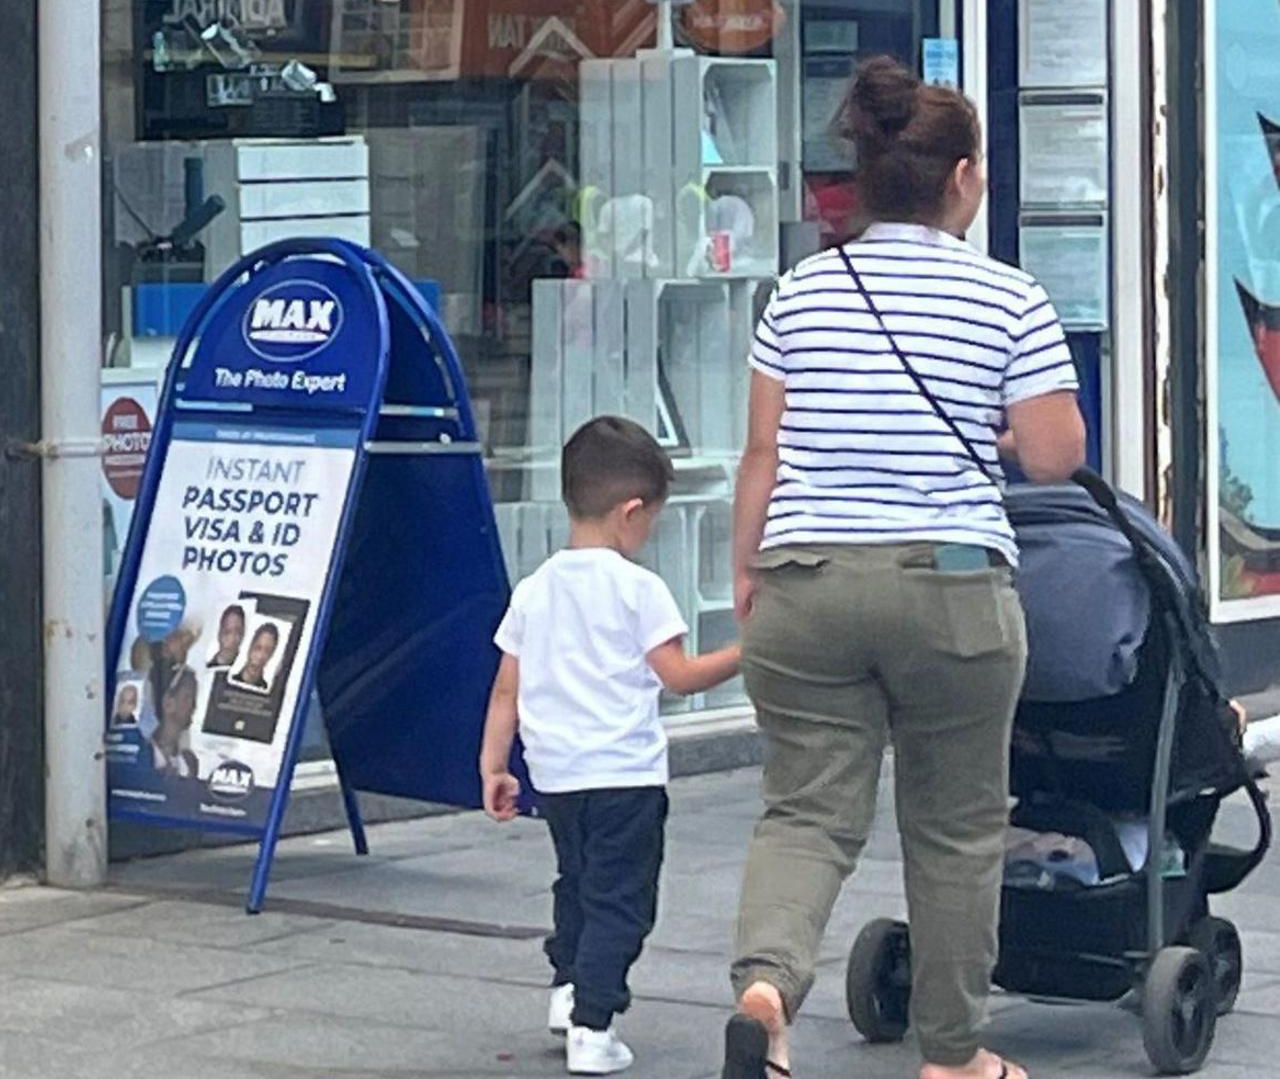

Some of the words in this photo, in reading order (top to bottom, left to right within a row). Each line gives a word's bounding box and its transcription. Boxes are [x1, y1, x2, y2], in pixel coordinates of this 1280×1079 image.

[251, 298, 333, 331] MAX
[215, 367, 242, 388] The
[244, 369, 289, 389] Photo
[290, 370, 347, 395] Expert
[206, 456, 306, 484] INSTANT
[182, 485, 318, 517] PASSPORT
[184, 516, 240, 543] VISA
[248, 520, 264, 544] &
[272, 522, 301, 547] ID
[182, 546, 289, 577] PHOTOS
